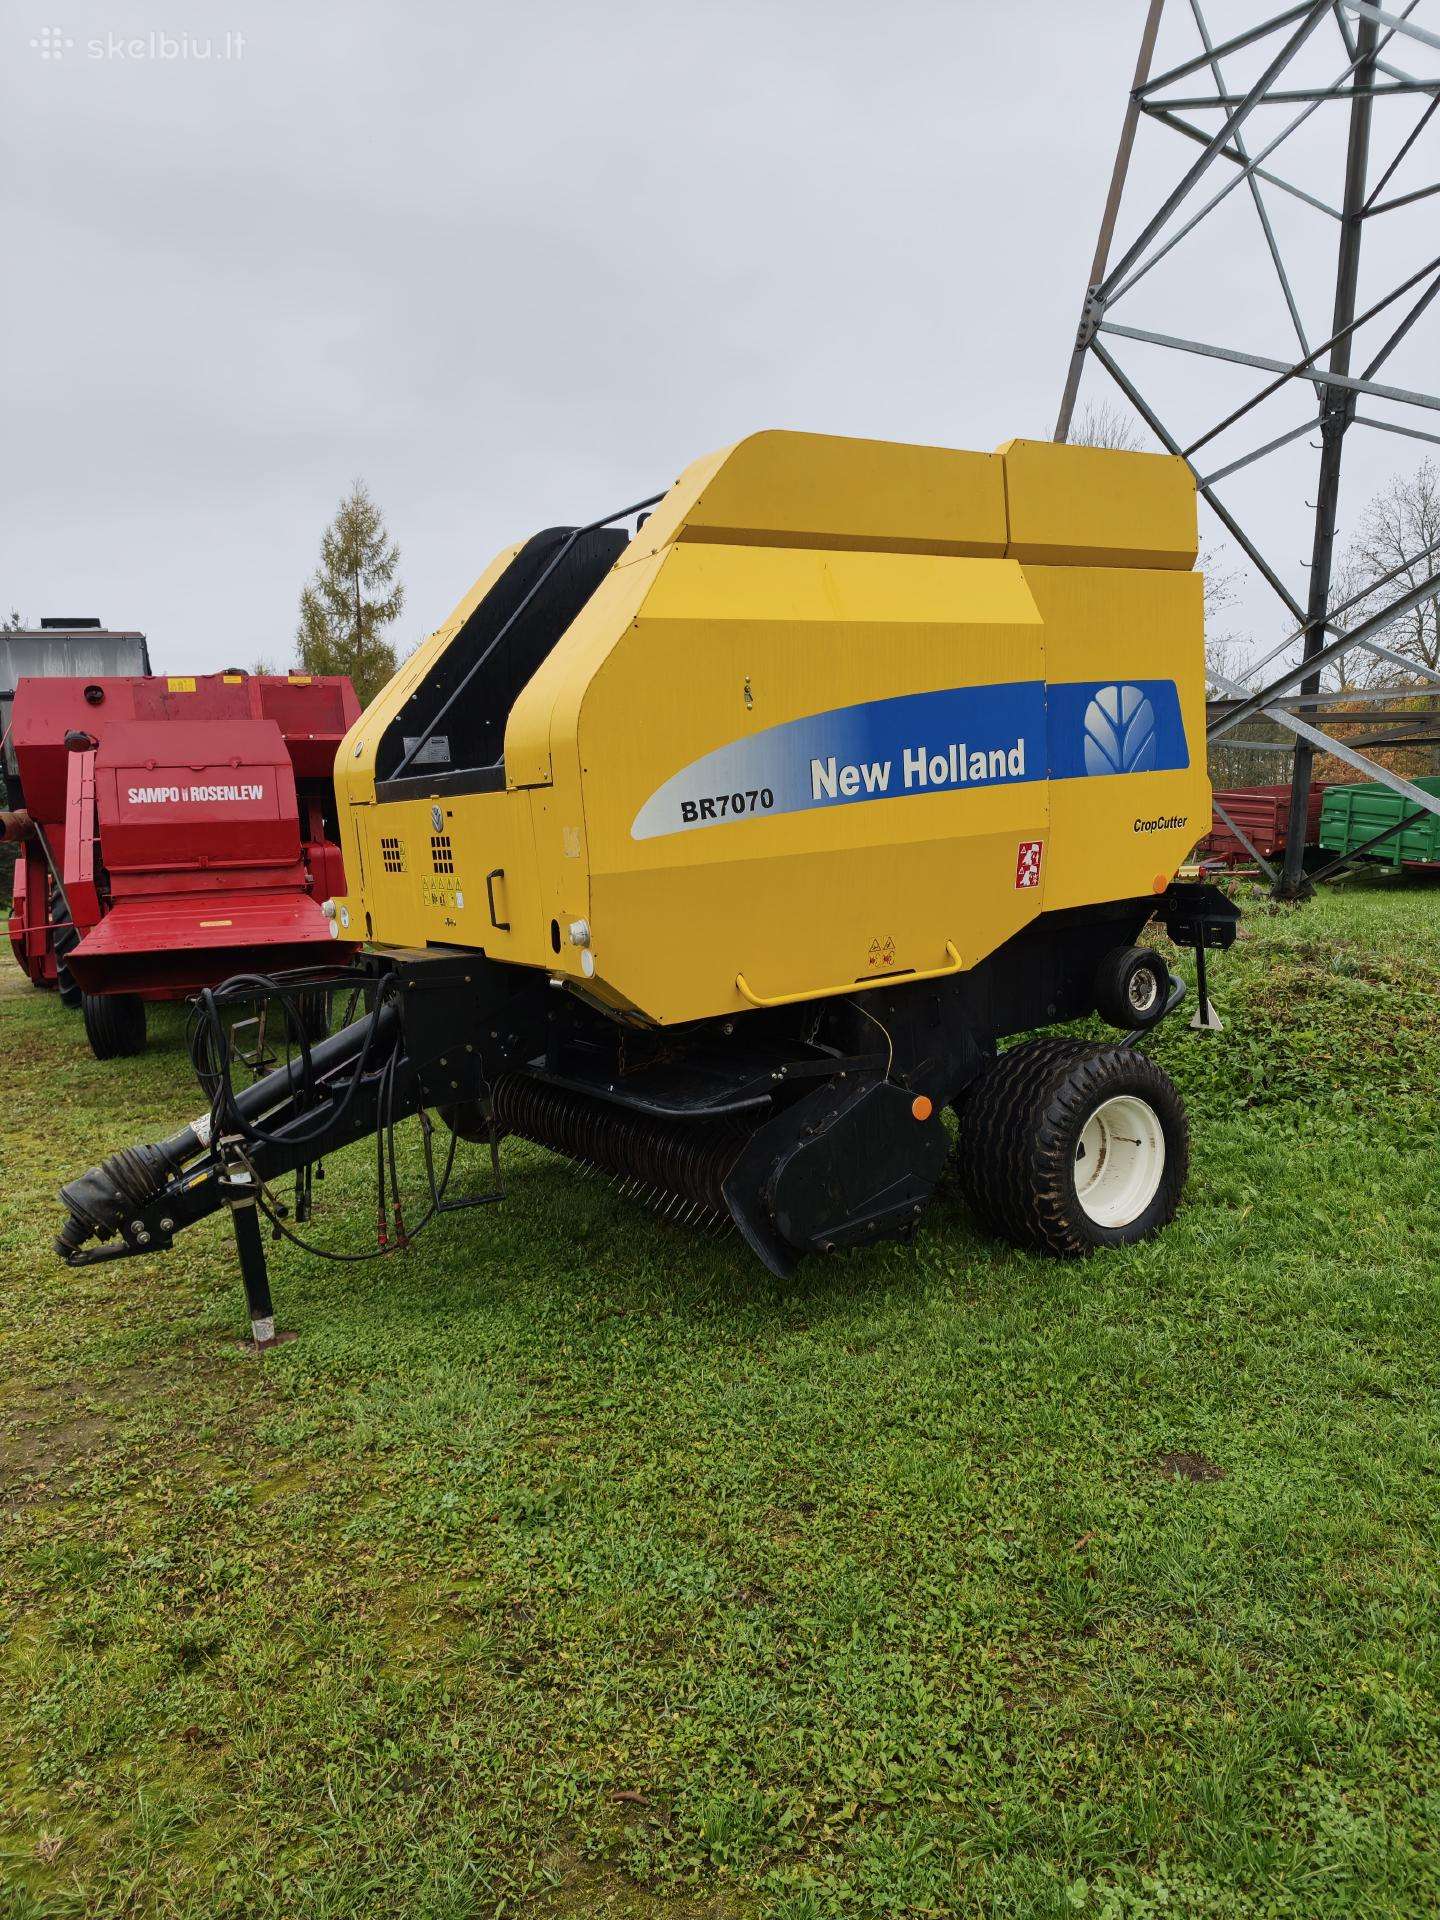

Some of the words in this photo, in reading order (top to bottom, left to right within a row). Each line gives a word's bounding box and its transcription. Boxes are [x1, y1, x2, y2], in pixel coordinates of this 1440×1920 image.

[810, 757, 892, 800] New
[902, 738, 1025, 788] Holland
[127, 786, 180, 804] SAMPO
[190, 784, 263, 802] ROSENLEW
[680, 788, 774, 823] BR7070
[1133, 815, 1188, 834] CropCutter
